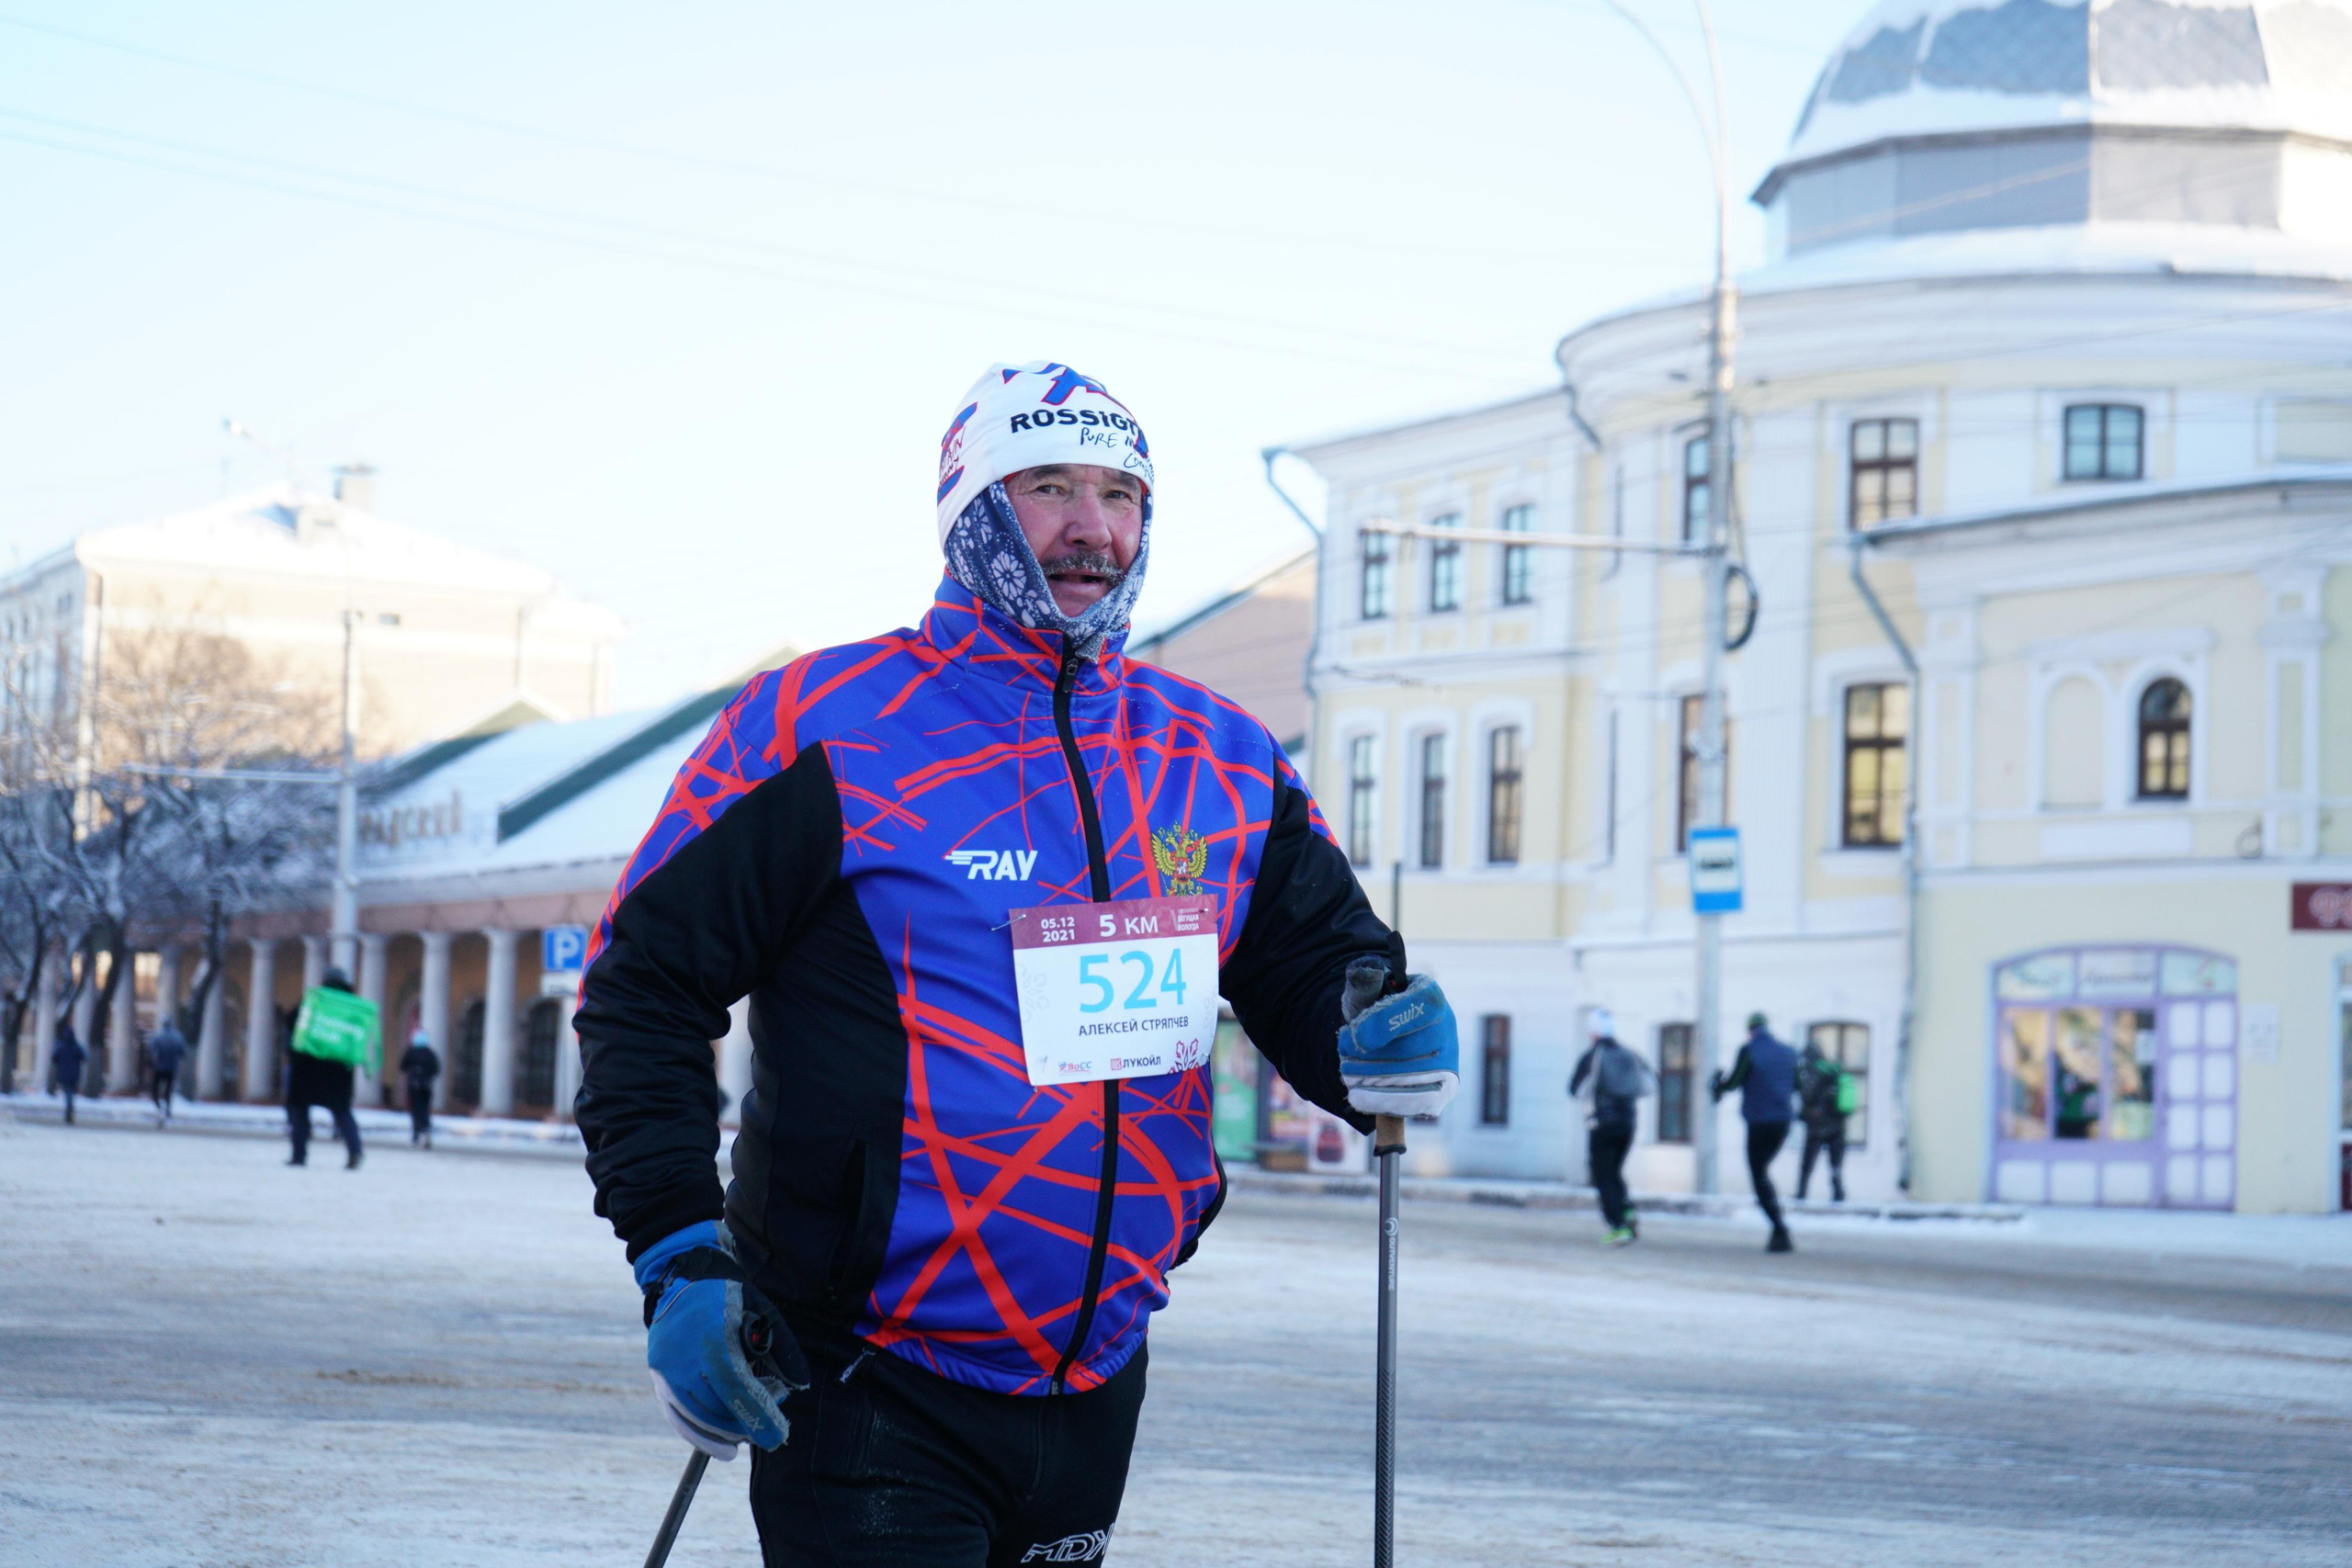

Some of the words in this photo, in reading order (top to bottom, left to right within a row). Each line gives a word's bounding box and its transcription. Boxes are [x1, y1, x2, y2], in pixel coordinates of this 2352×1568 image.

[944, 850, 1038, 881] RAY
[1041, 917, 1076, 930] 05.12
[1100, 914, 1117, 937] 5
[1043, 929, 1076, 942] 2021
[554, 931, 580, 968] P
[1080, 948, 1187, 1013] 524
[1079, 1019, 1138, 1036] АЛЕКСЕЙ
[1141, 1016, 1189, 1032] СТРЯПЧЕВ
[1123, 1055, 1161, 1068] ЛУКОЙЛ
[1388, 1236, 1396, 1292] OUTVENTURE
